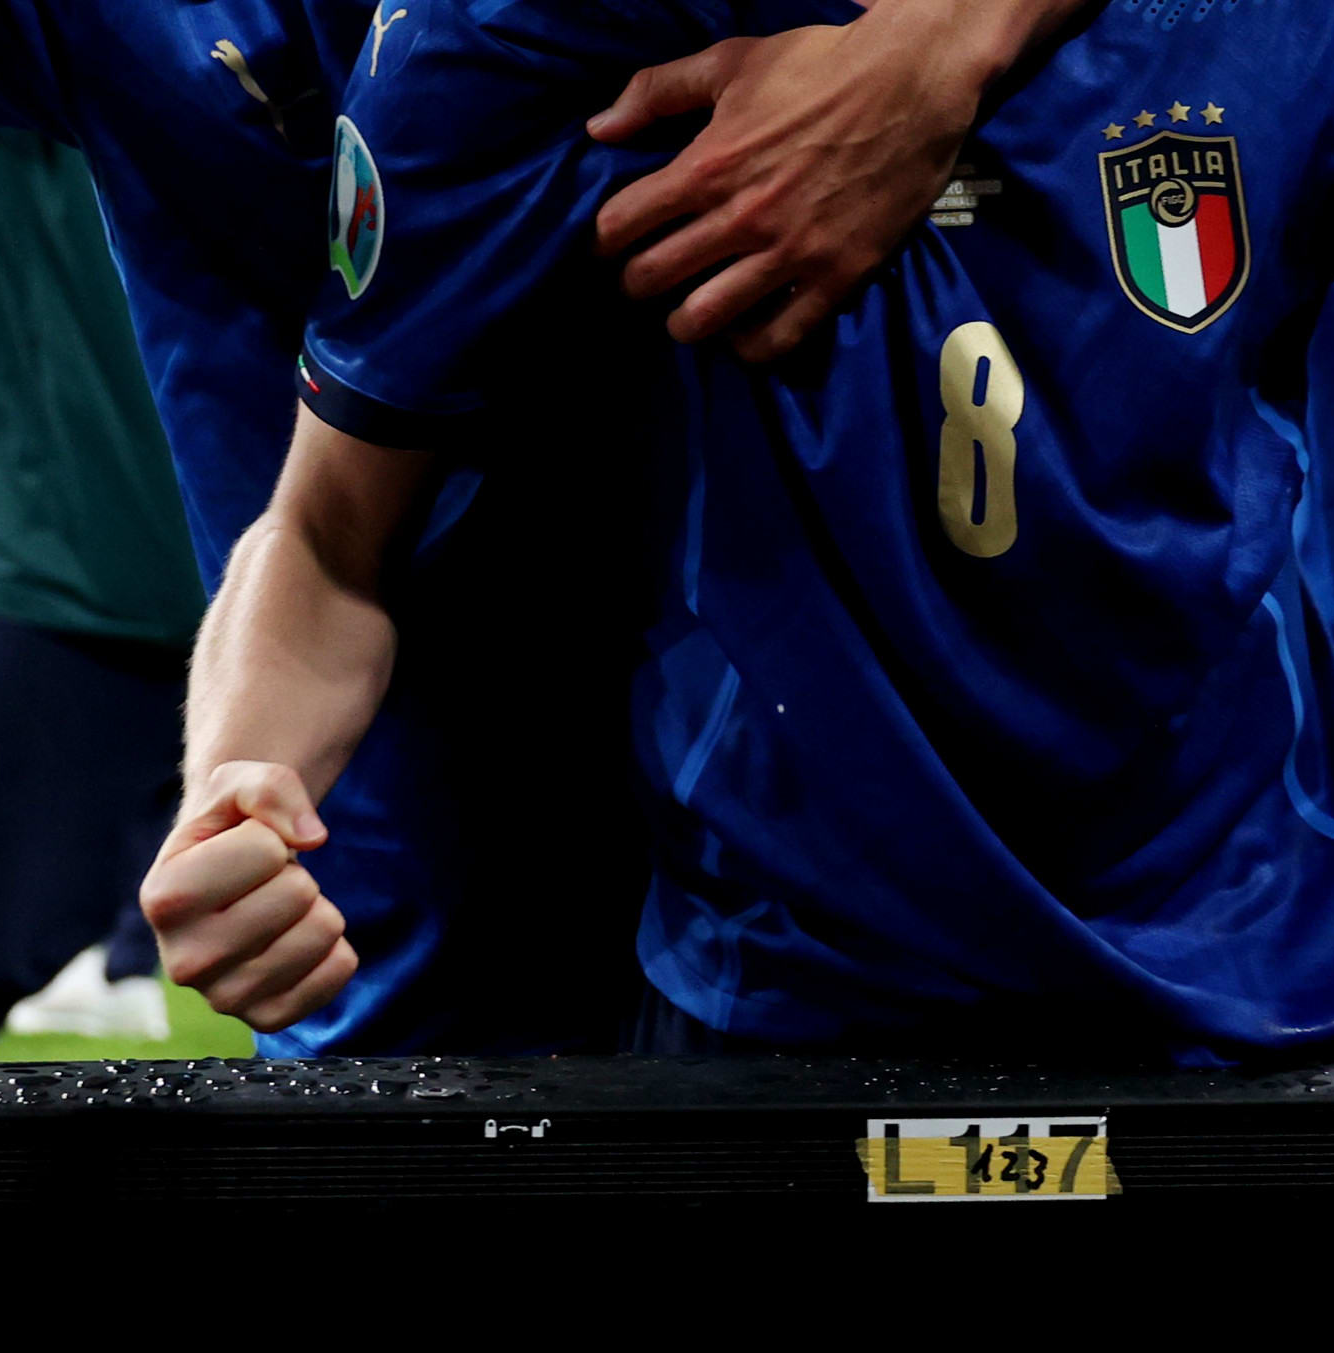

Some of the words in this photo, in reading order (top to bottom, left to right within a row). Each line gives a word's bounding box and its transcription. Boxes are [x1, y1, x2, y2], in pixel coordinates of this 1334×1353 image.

[1113, 150, 1225, 189] ITALIA
[937, 321, 1024, 558] 8
[971, 1143, 1048, 1190] 123
